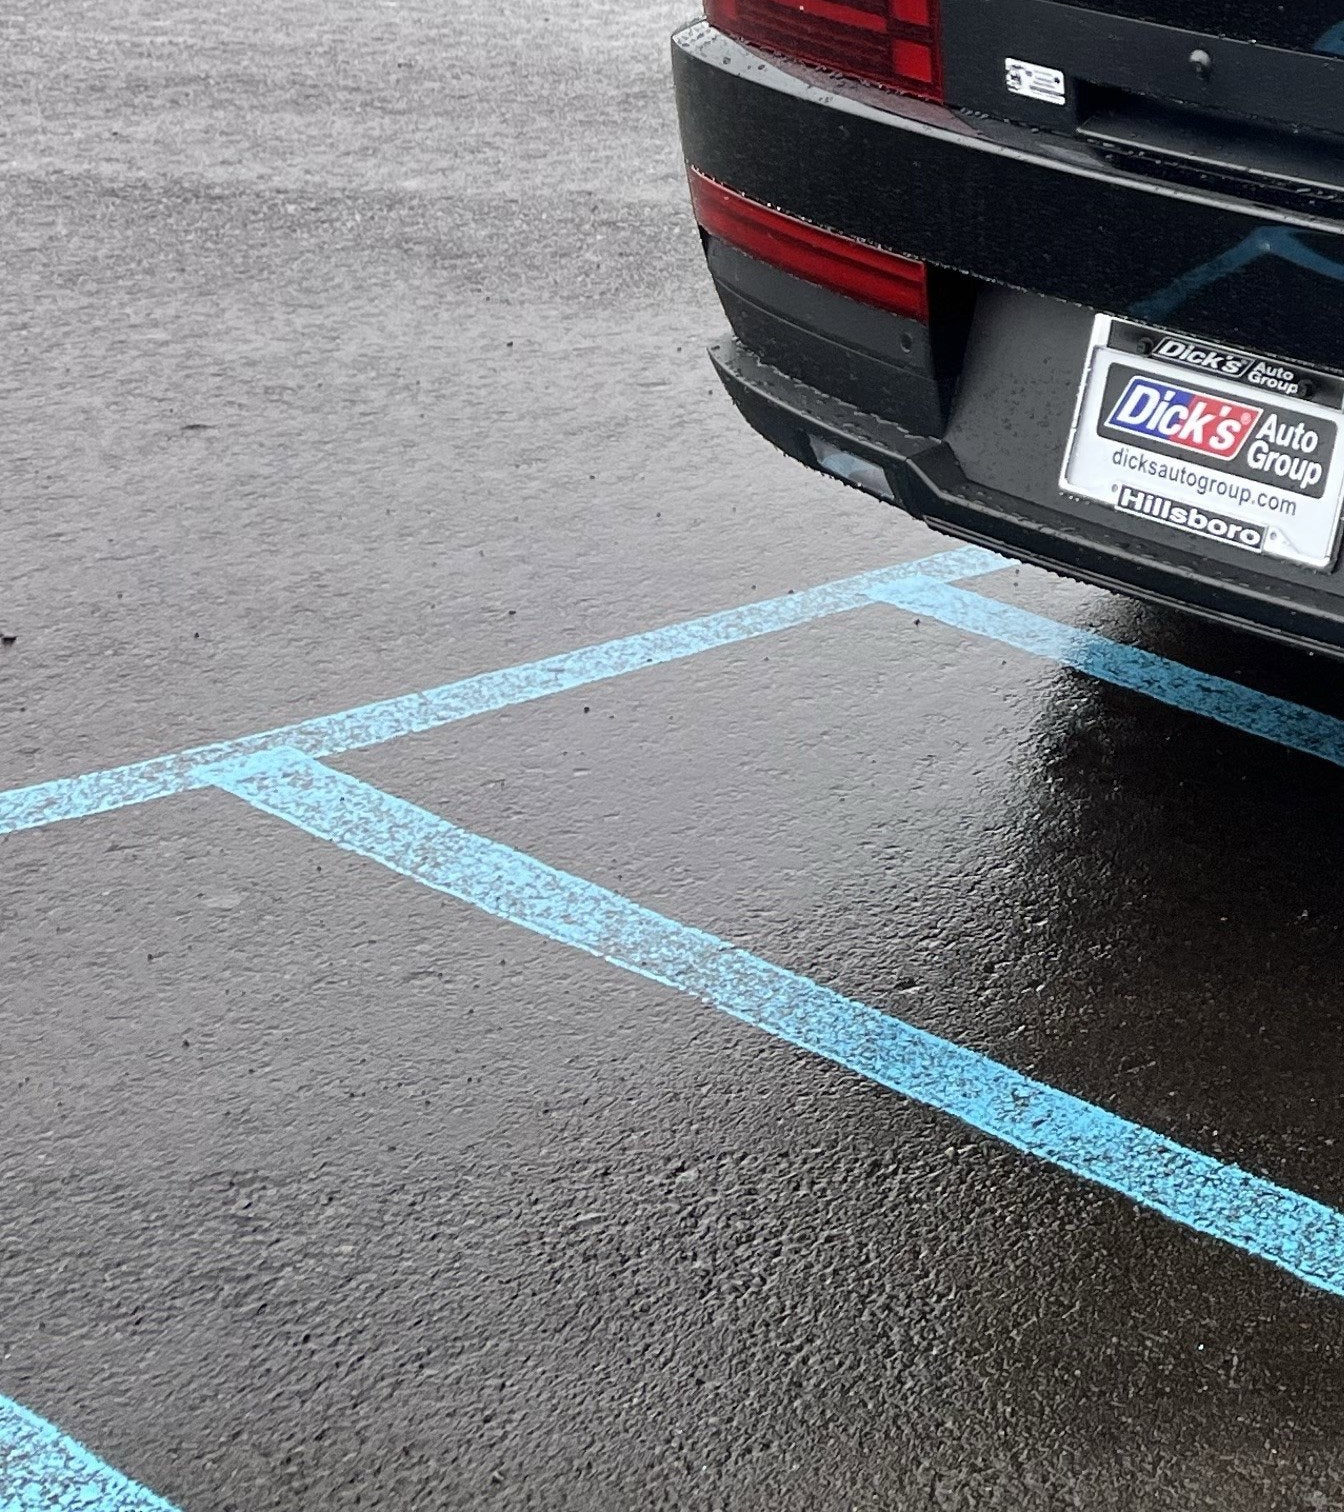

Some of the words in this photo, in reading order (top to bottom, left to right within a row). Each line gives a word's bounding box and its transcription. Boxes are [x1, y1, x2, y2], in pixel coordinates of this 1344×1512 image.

[1157, 339, 1243, 375] Dick's
[1252, 360, 1295, 382] Auto
[1247, 370, 1299, 395] Group
[1114, 383, 1245, 452] Dick's
[1256, 413, 1319, 454] Auto
[1111, 447, 1298, 517] dicksautogroup.com
[1246, 442, 1323, 489] Group
[1118, 485, 1263, 546] Hillsboro
